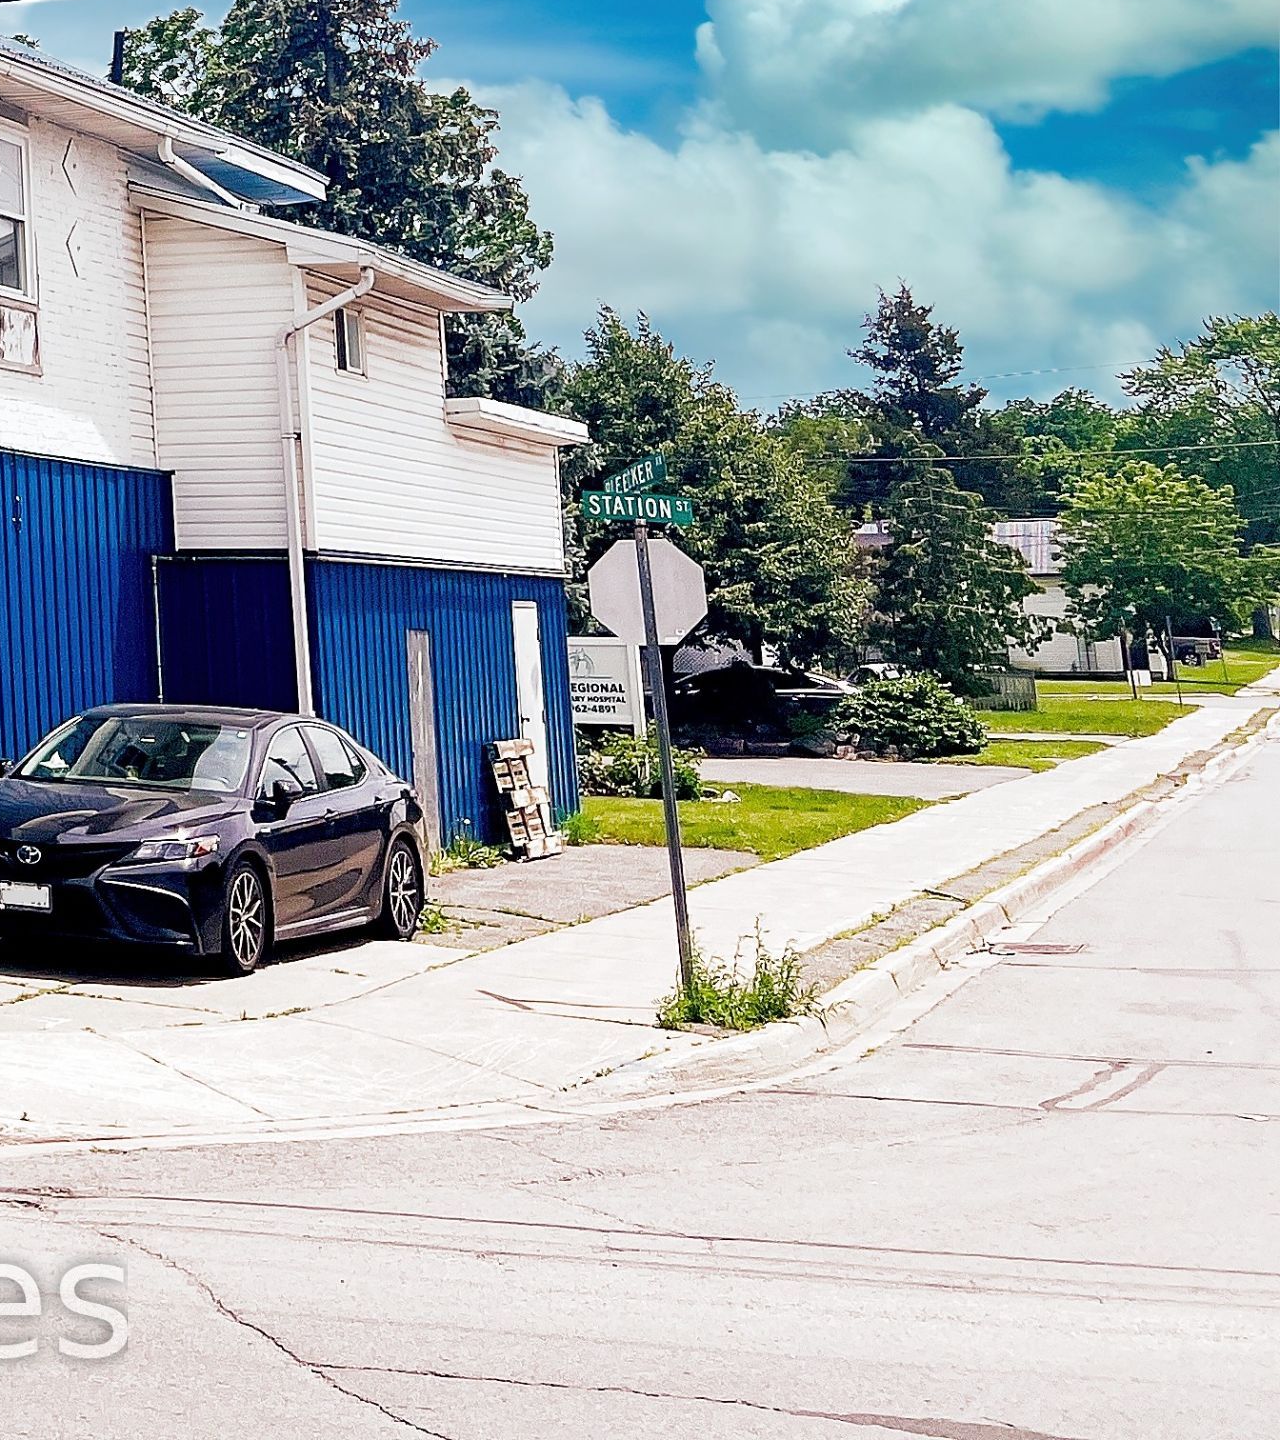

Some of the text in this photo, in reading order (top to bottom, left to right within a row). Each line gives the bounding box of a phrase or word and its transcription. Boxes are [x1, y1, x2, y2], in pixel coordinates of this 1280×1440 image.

[588, 494, 689, 519] STATION ST
[571, 682, 626, 693] EGIONAL
